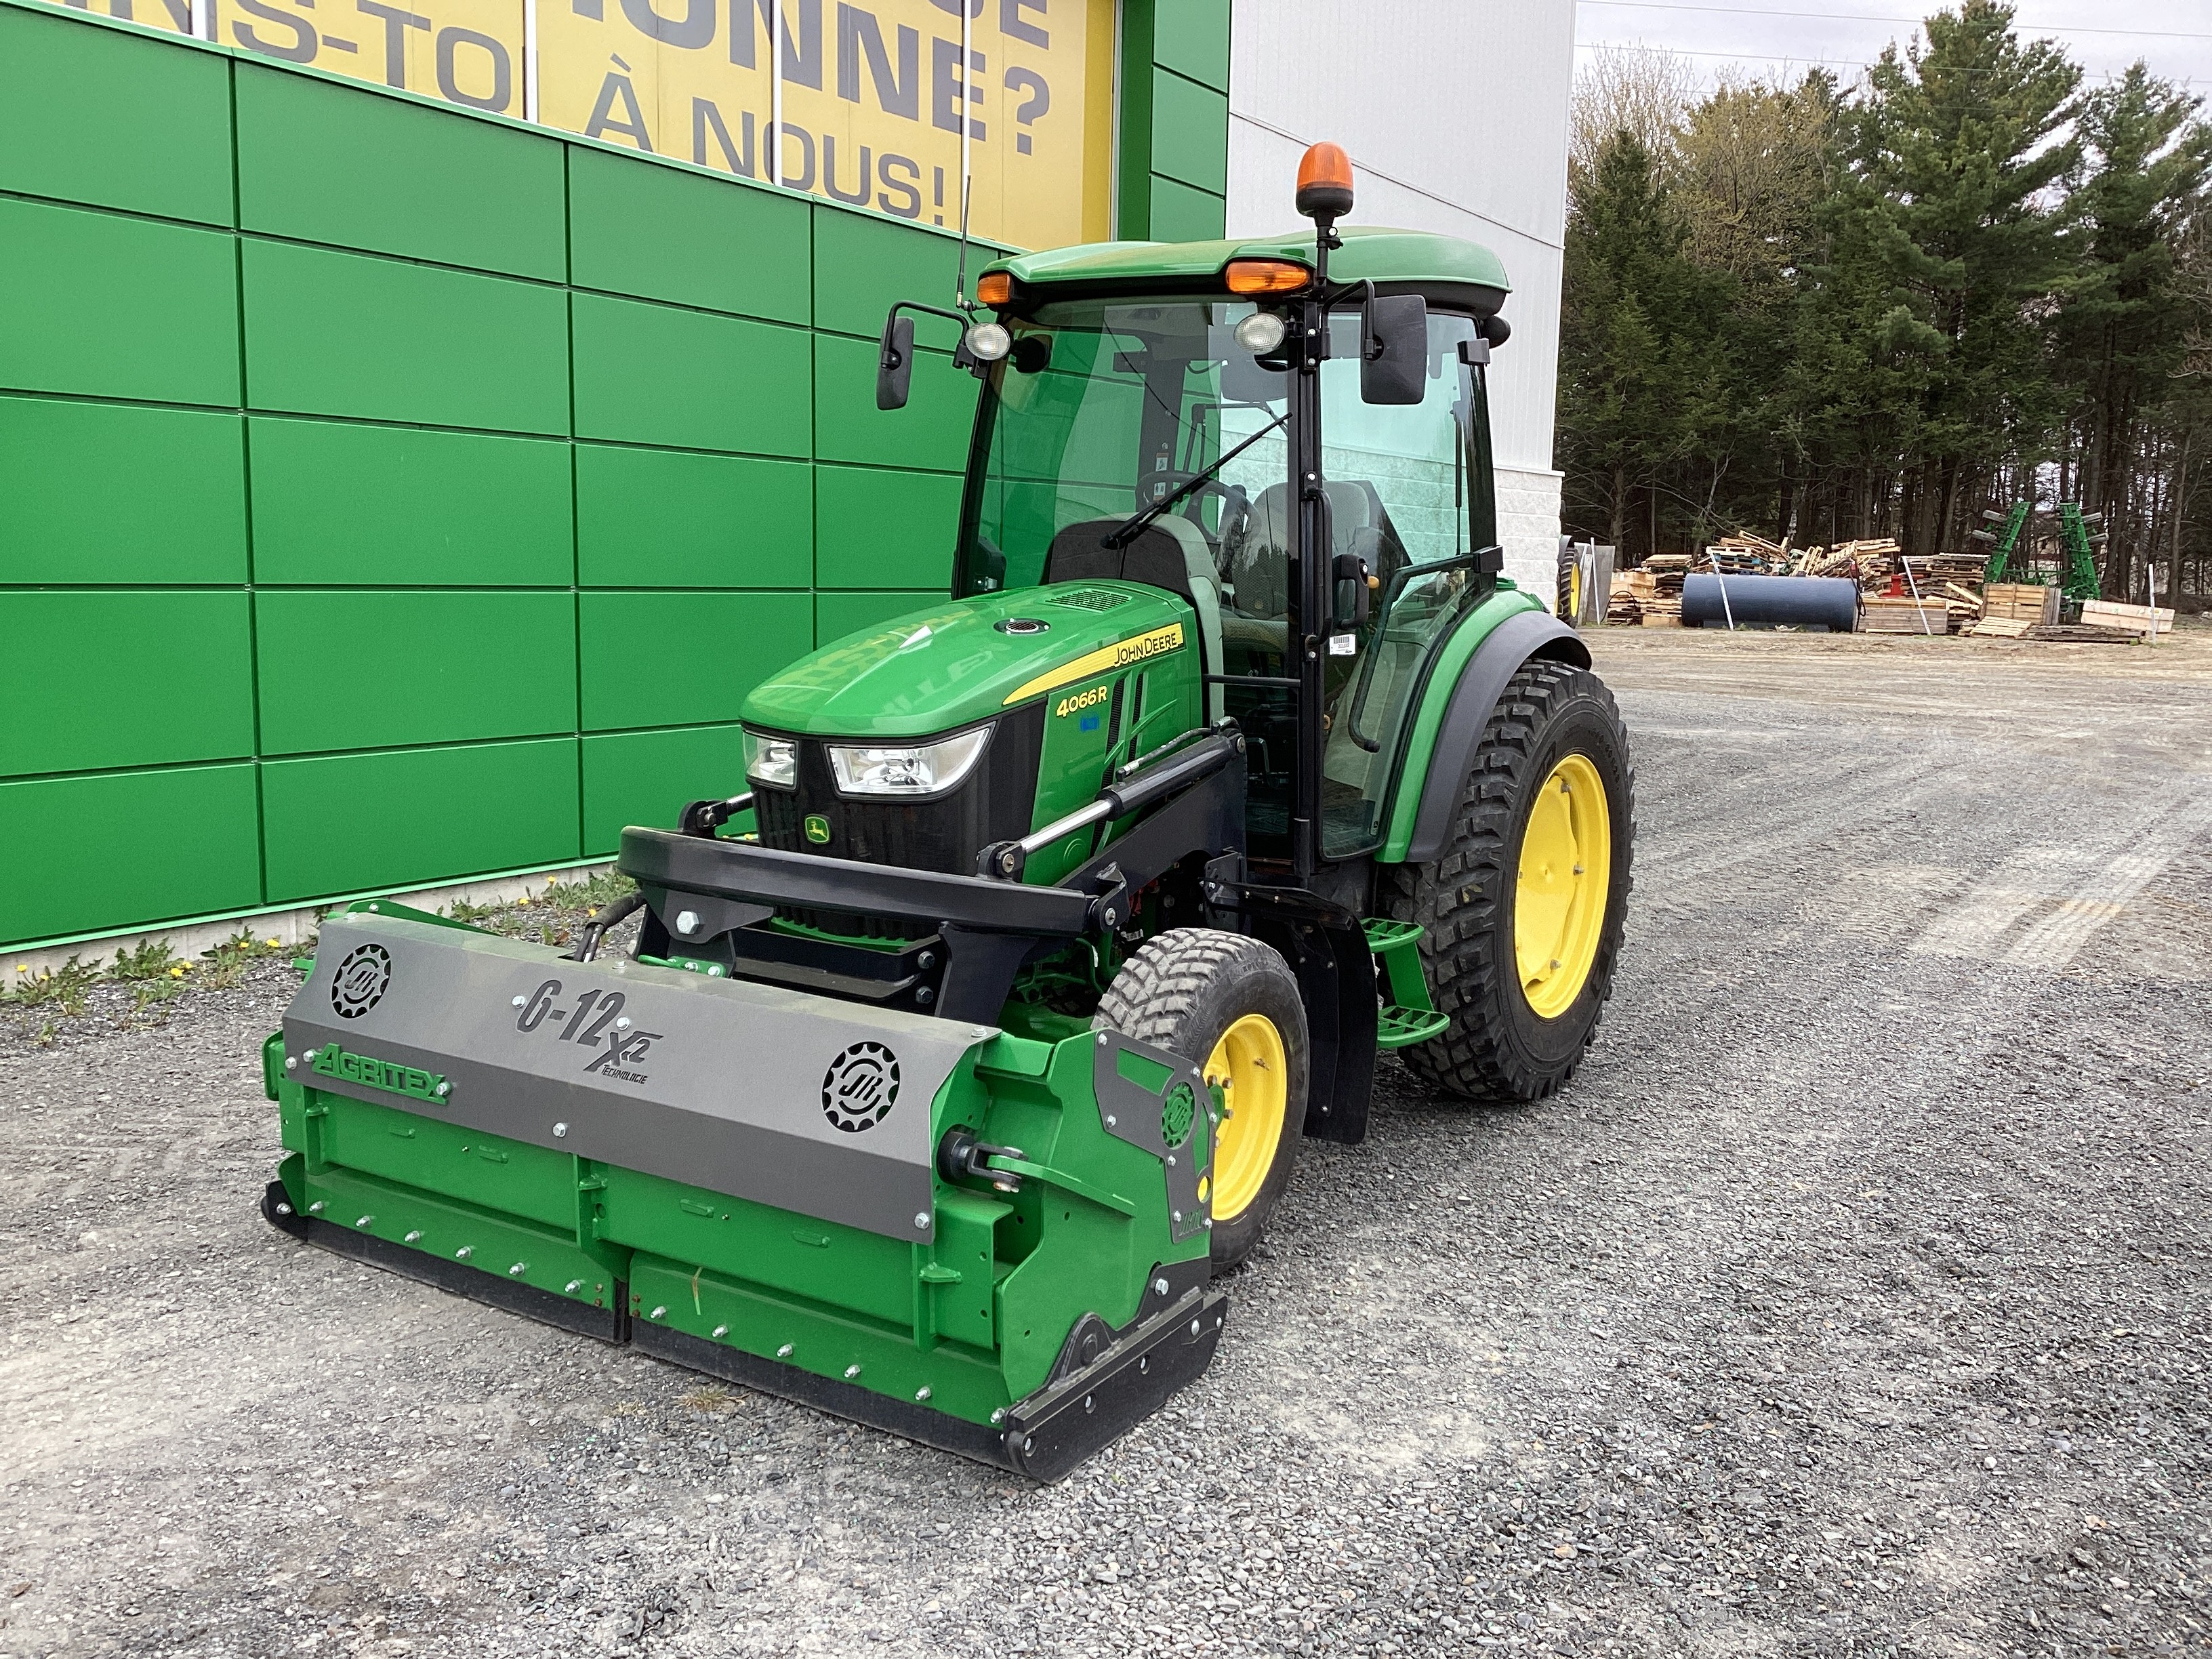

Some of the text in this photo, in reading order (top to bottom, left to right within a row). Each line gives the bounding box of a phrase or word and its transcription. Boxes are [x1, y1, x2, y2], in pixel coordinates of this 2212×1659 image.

[572, 0, 1050, 157] NNE?
[584, 52, 654, 152] À
[692, 96, 943, 226] NOUS!
[1114, 632, 1177, 665] JOHN DEERE
[1056, 684, 1108, 718] 4066R
[312, 1042, 449, 1105] AGRITEX
